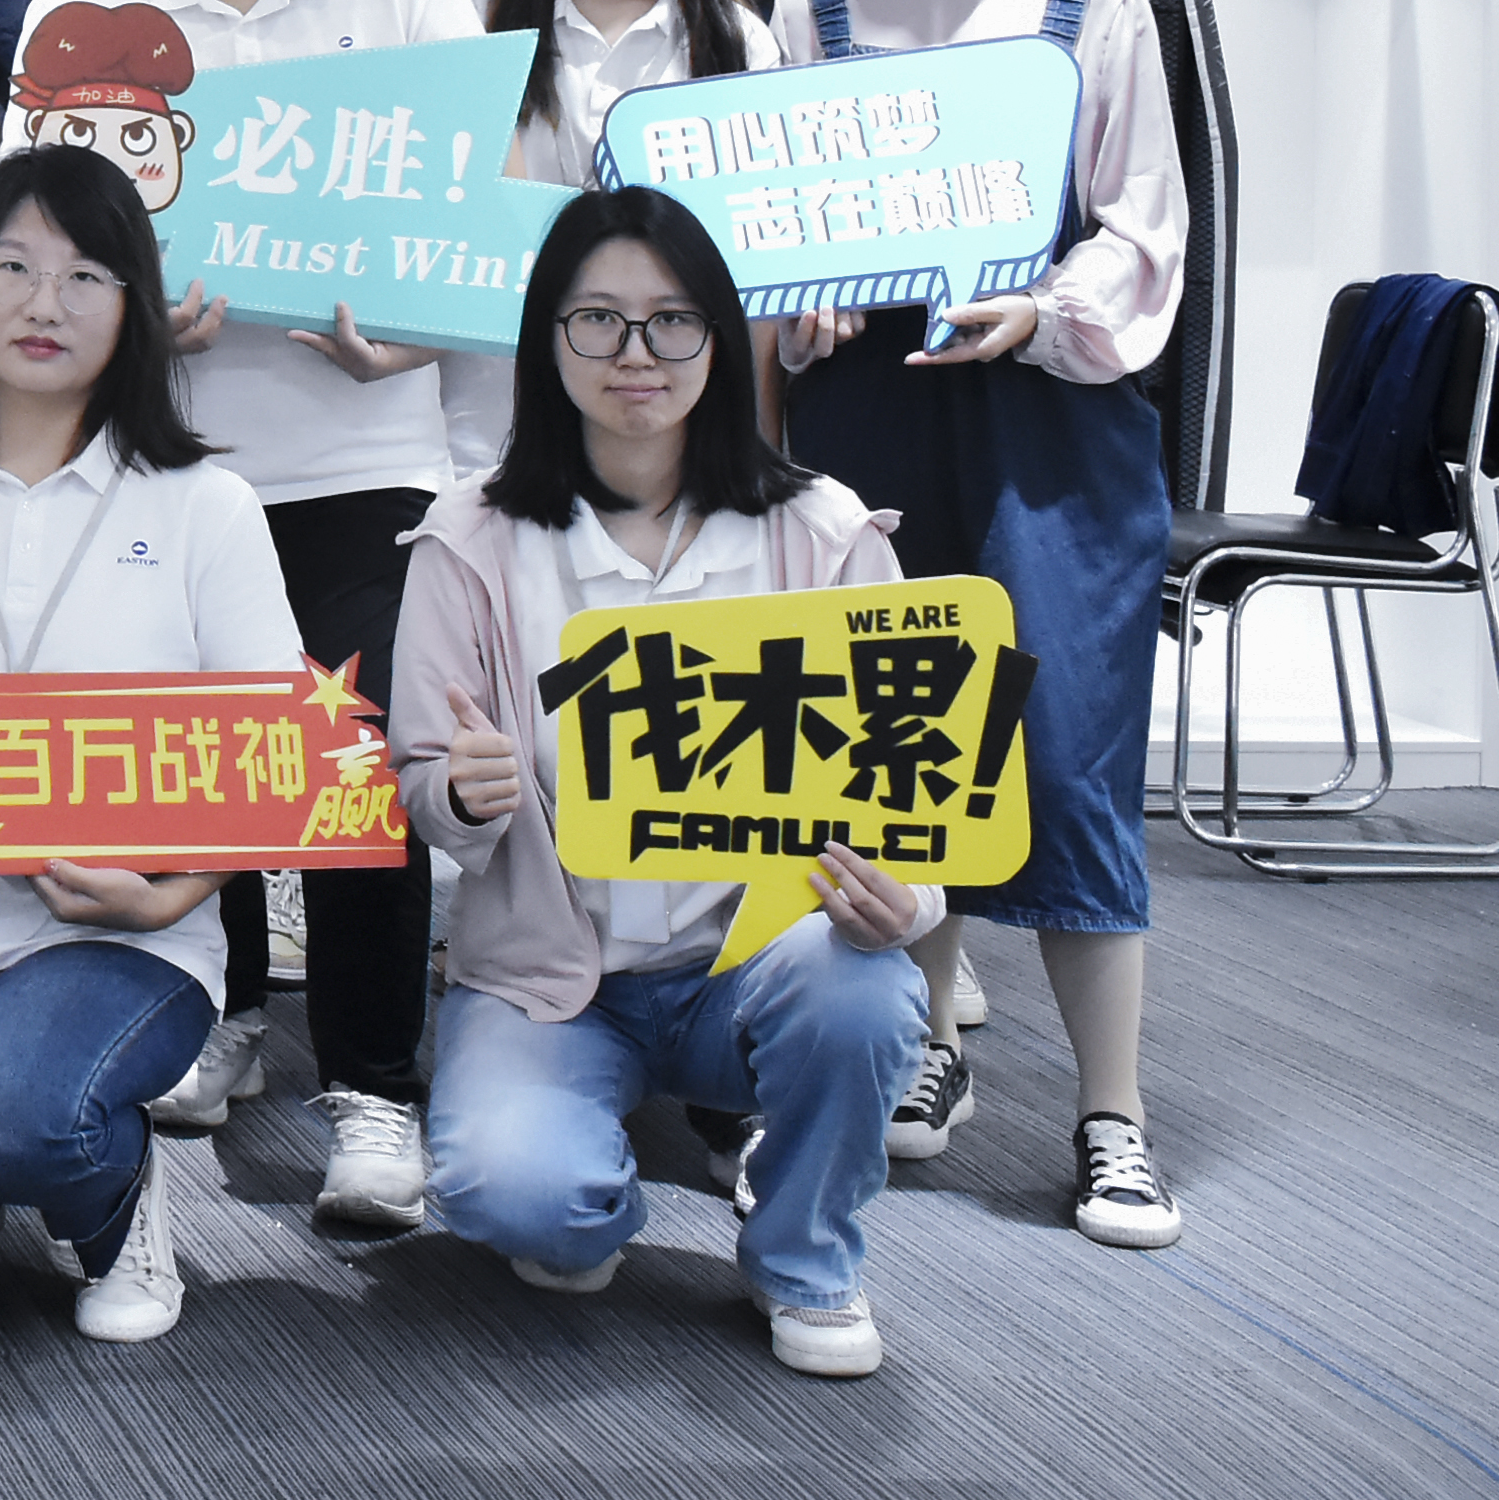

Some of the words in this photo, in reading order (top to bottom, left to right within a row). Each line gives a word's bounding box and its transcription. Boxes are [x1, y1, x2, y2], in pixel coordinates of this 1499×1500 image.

[641, 89, 941, 184] 用心筑梦
[725, 159, 1035, 252] 志在巅峰
[203, 221, 371, 278] Must
[392, 235, 536, 294] Win!
[116, 557, 159, 567] EASTON
[846, 608, 892, 634] WE
[901, 603, 961, 631] ARE
[299, 728, 406, 846] 赢
